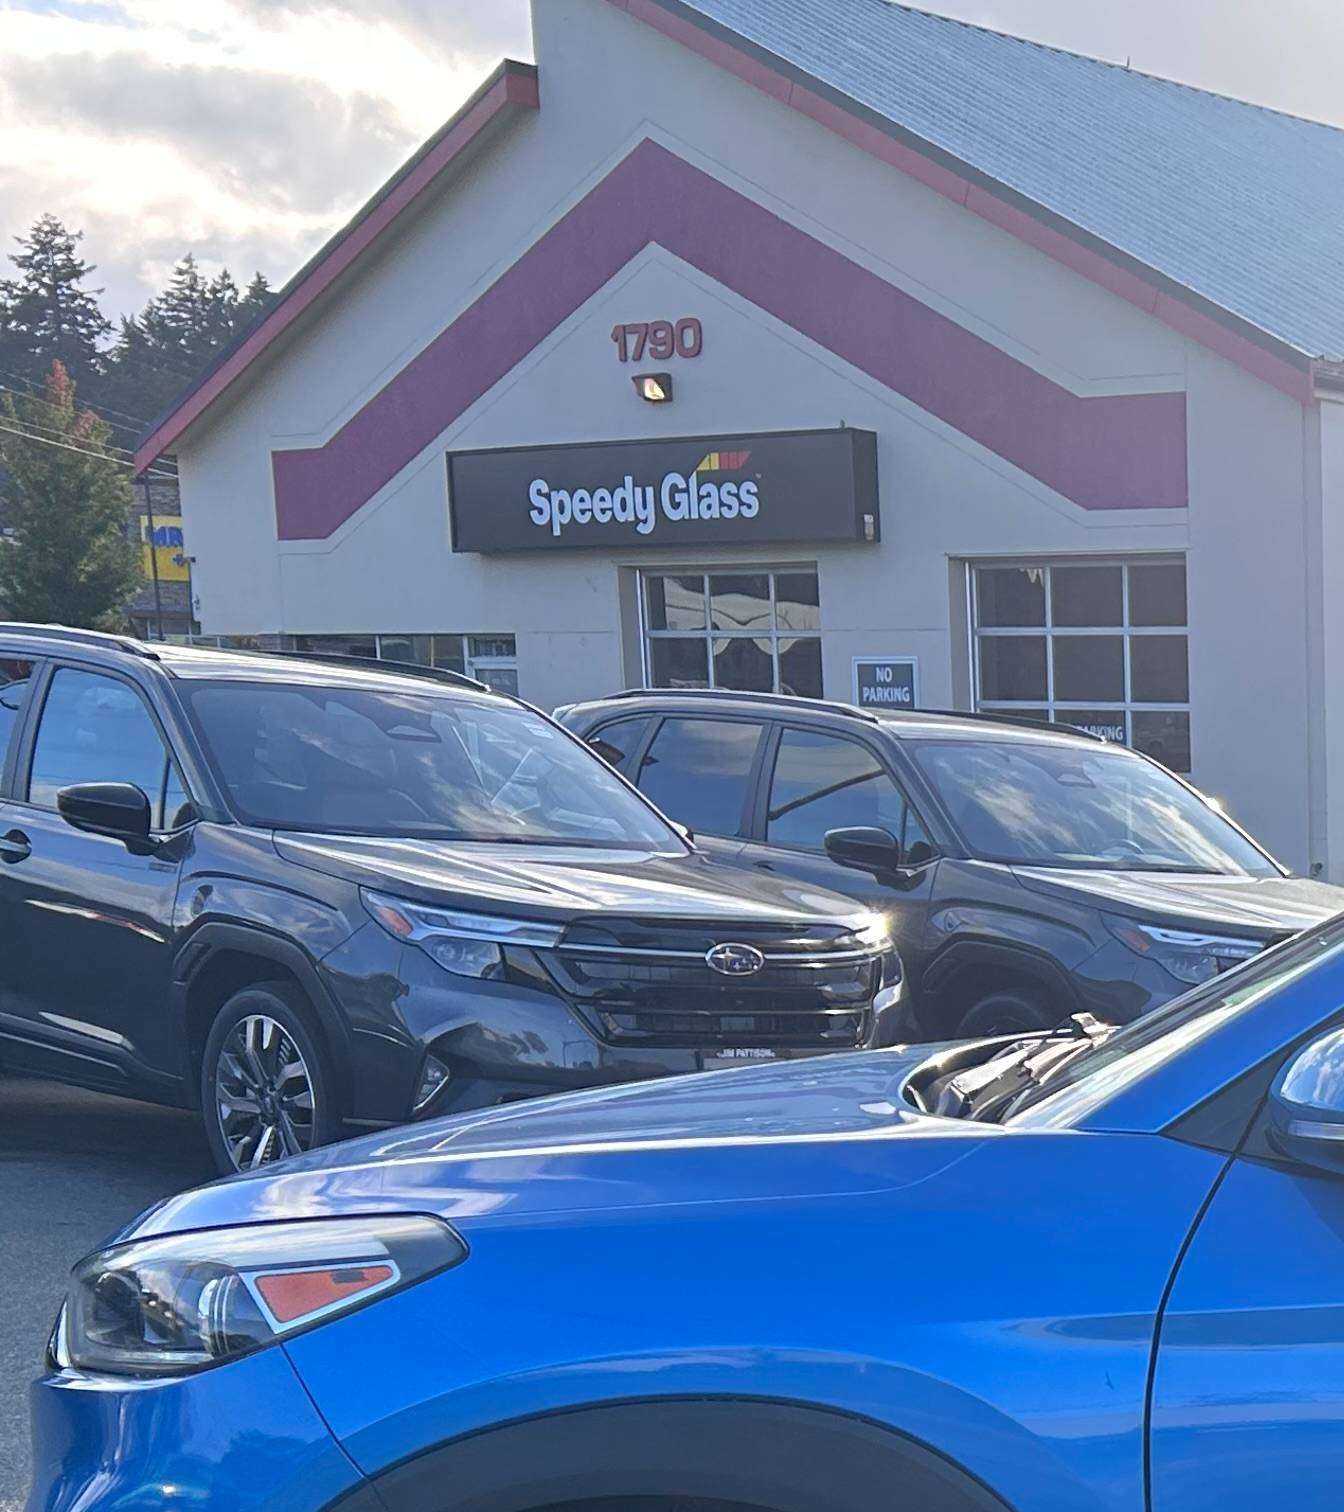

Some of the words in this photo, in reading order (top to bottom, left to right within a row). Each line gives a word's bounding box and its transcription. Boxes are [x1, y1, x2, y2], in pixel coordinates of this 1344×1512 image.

[611, 317, 702, 362] 1790
[529, 475, 655, 536] Speedy
[661, 470, 758, 520] Glass
[876, 667, 892, 682] NO
[862, 687, 910, 702] PARKING
